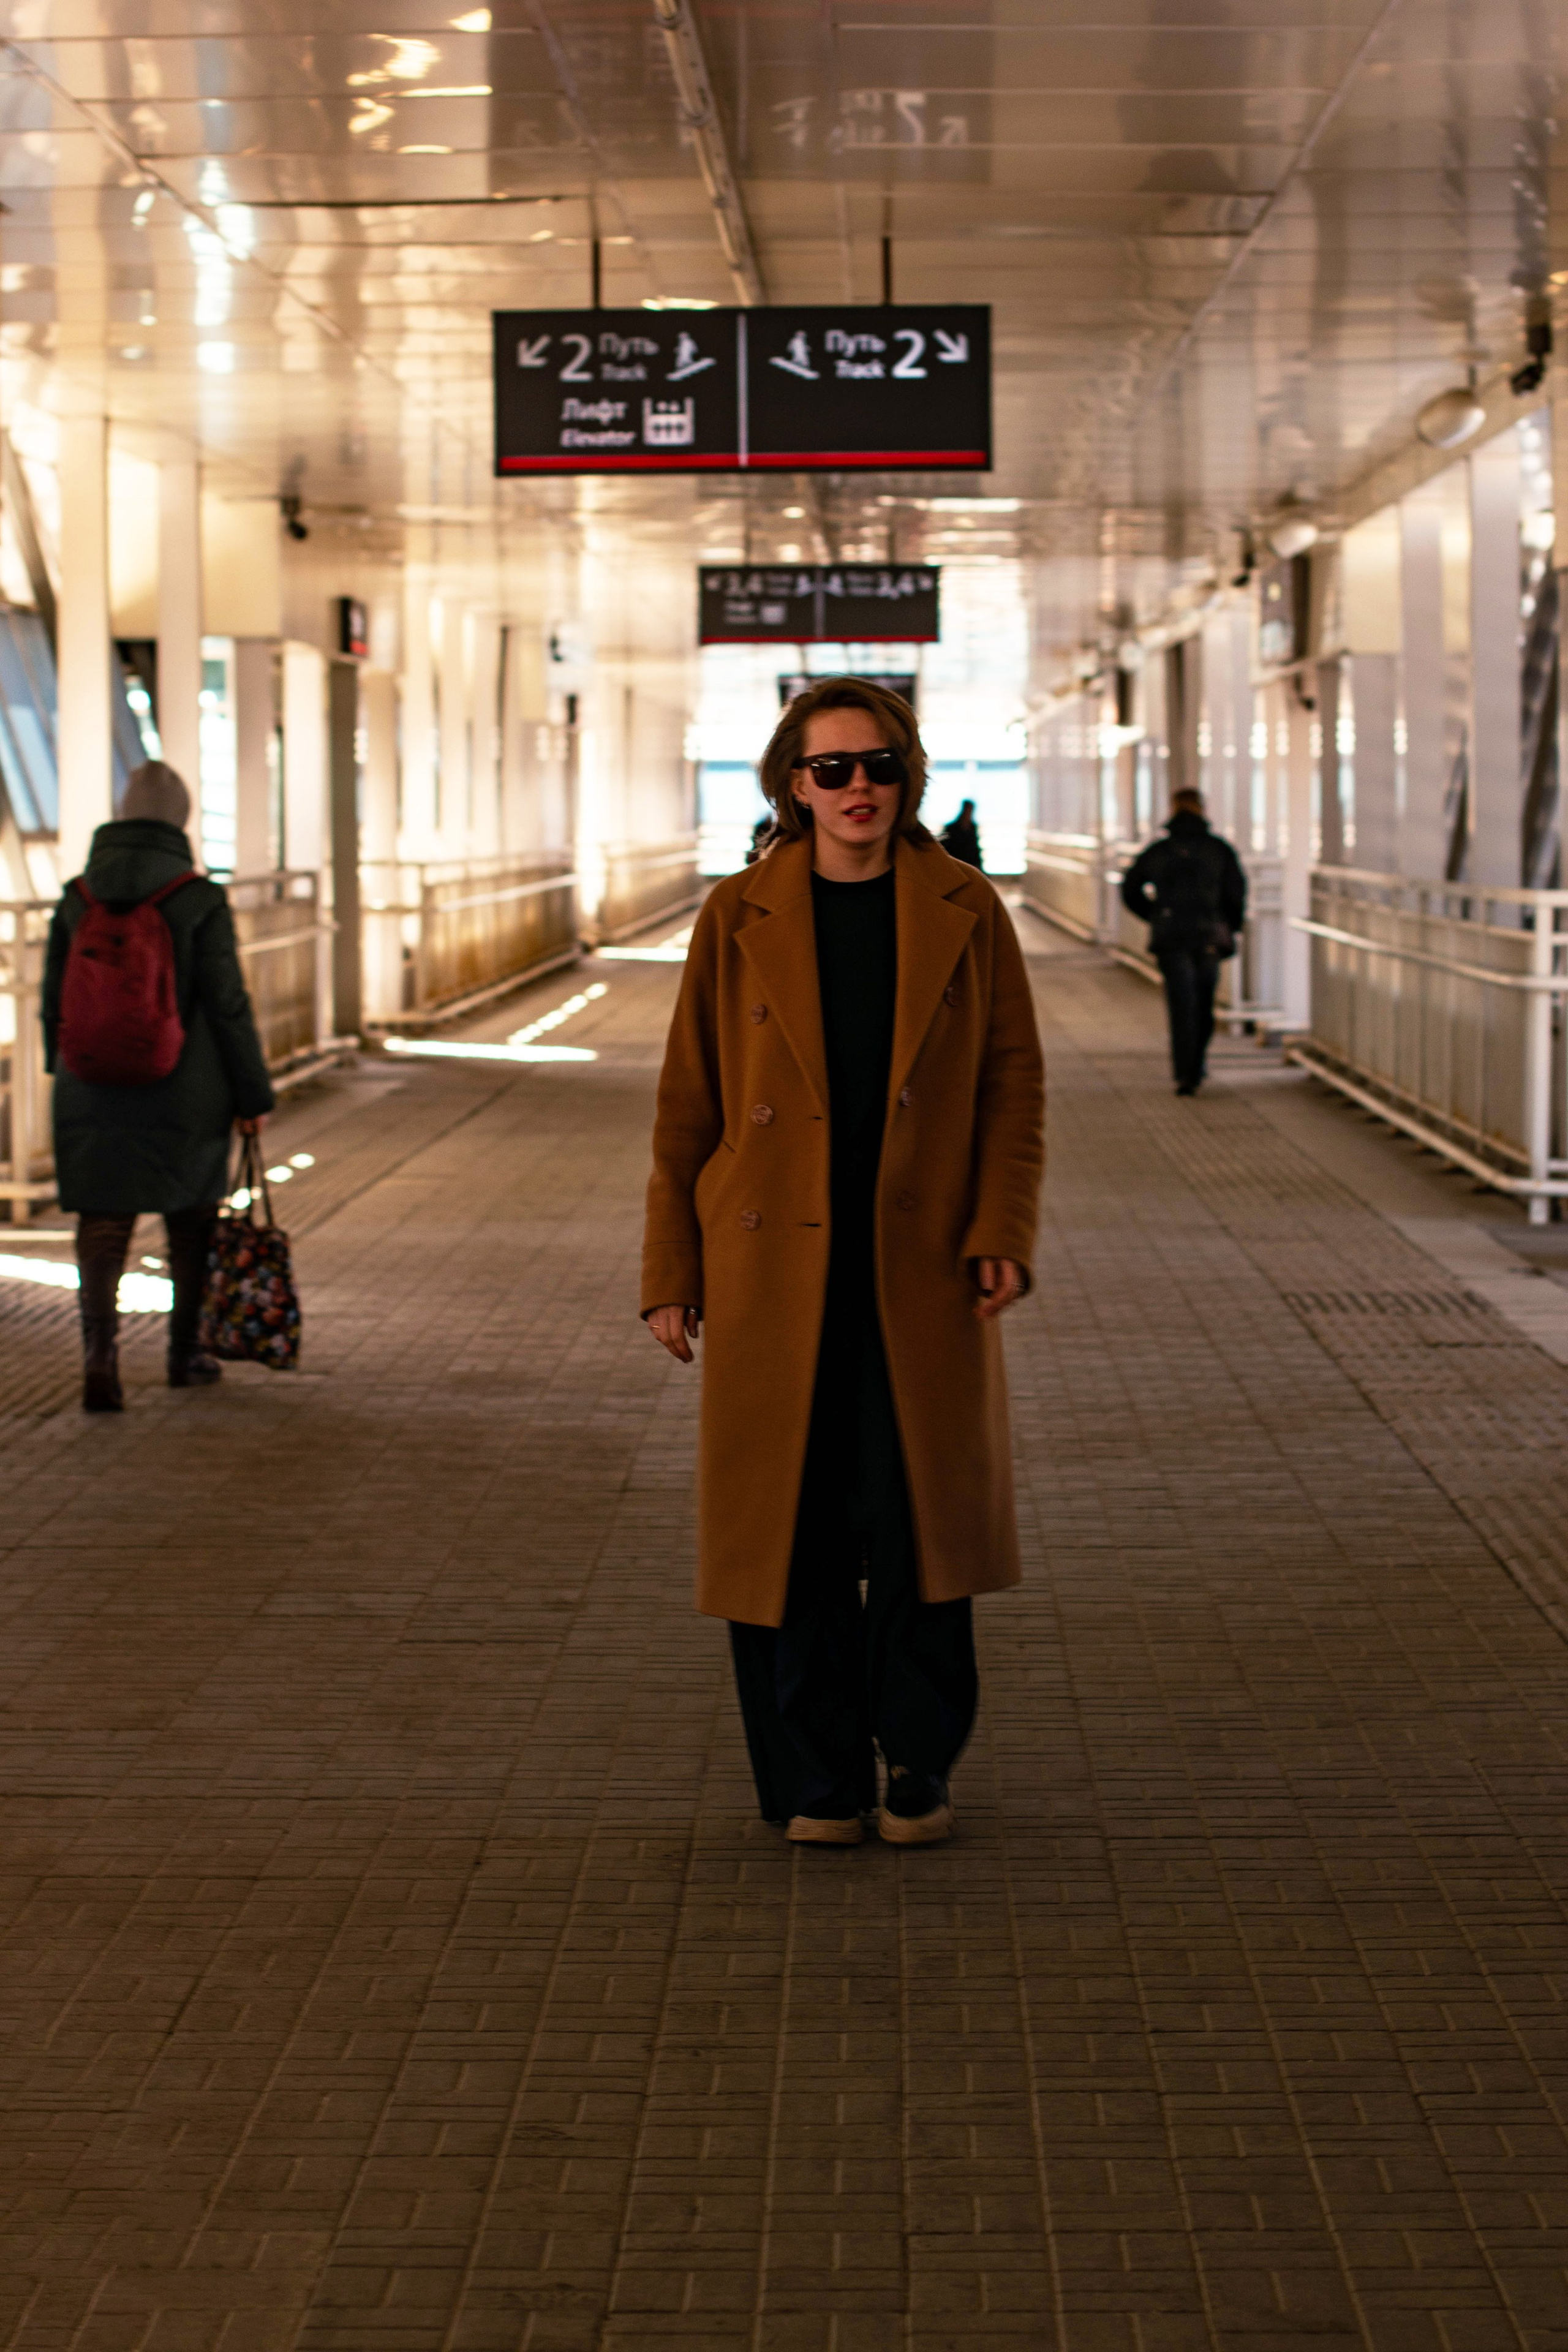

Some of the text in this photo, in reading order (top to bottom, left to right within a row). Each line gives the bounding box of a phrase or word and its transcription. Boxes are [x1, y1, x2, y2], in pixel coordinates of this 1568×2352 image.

[560, 333, 660, 381] 2 Путь
[825, 329, 927, 379] Путь 2
[561, 398, 627, 425] Лифт
[560, 429, 636, 447] Elevator
